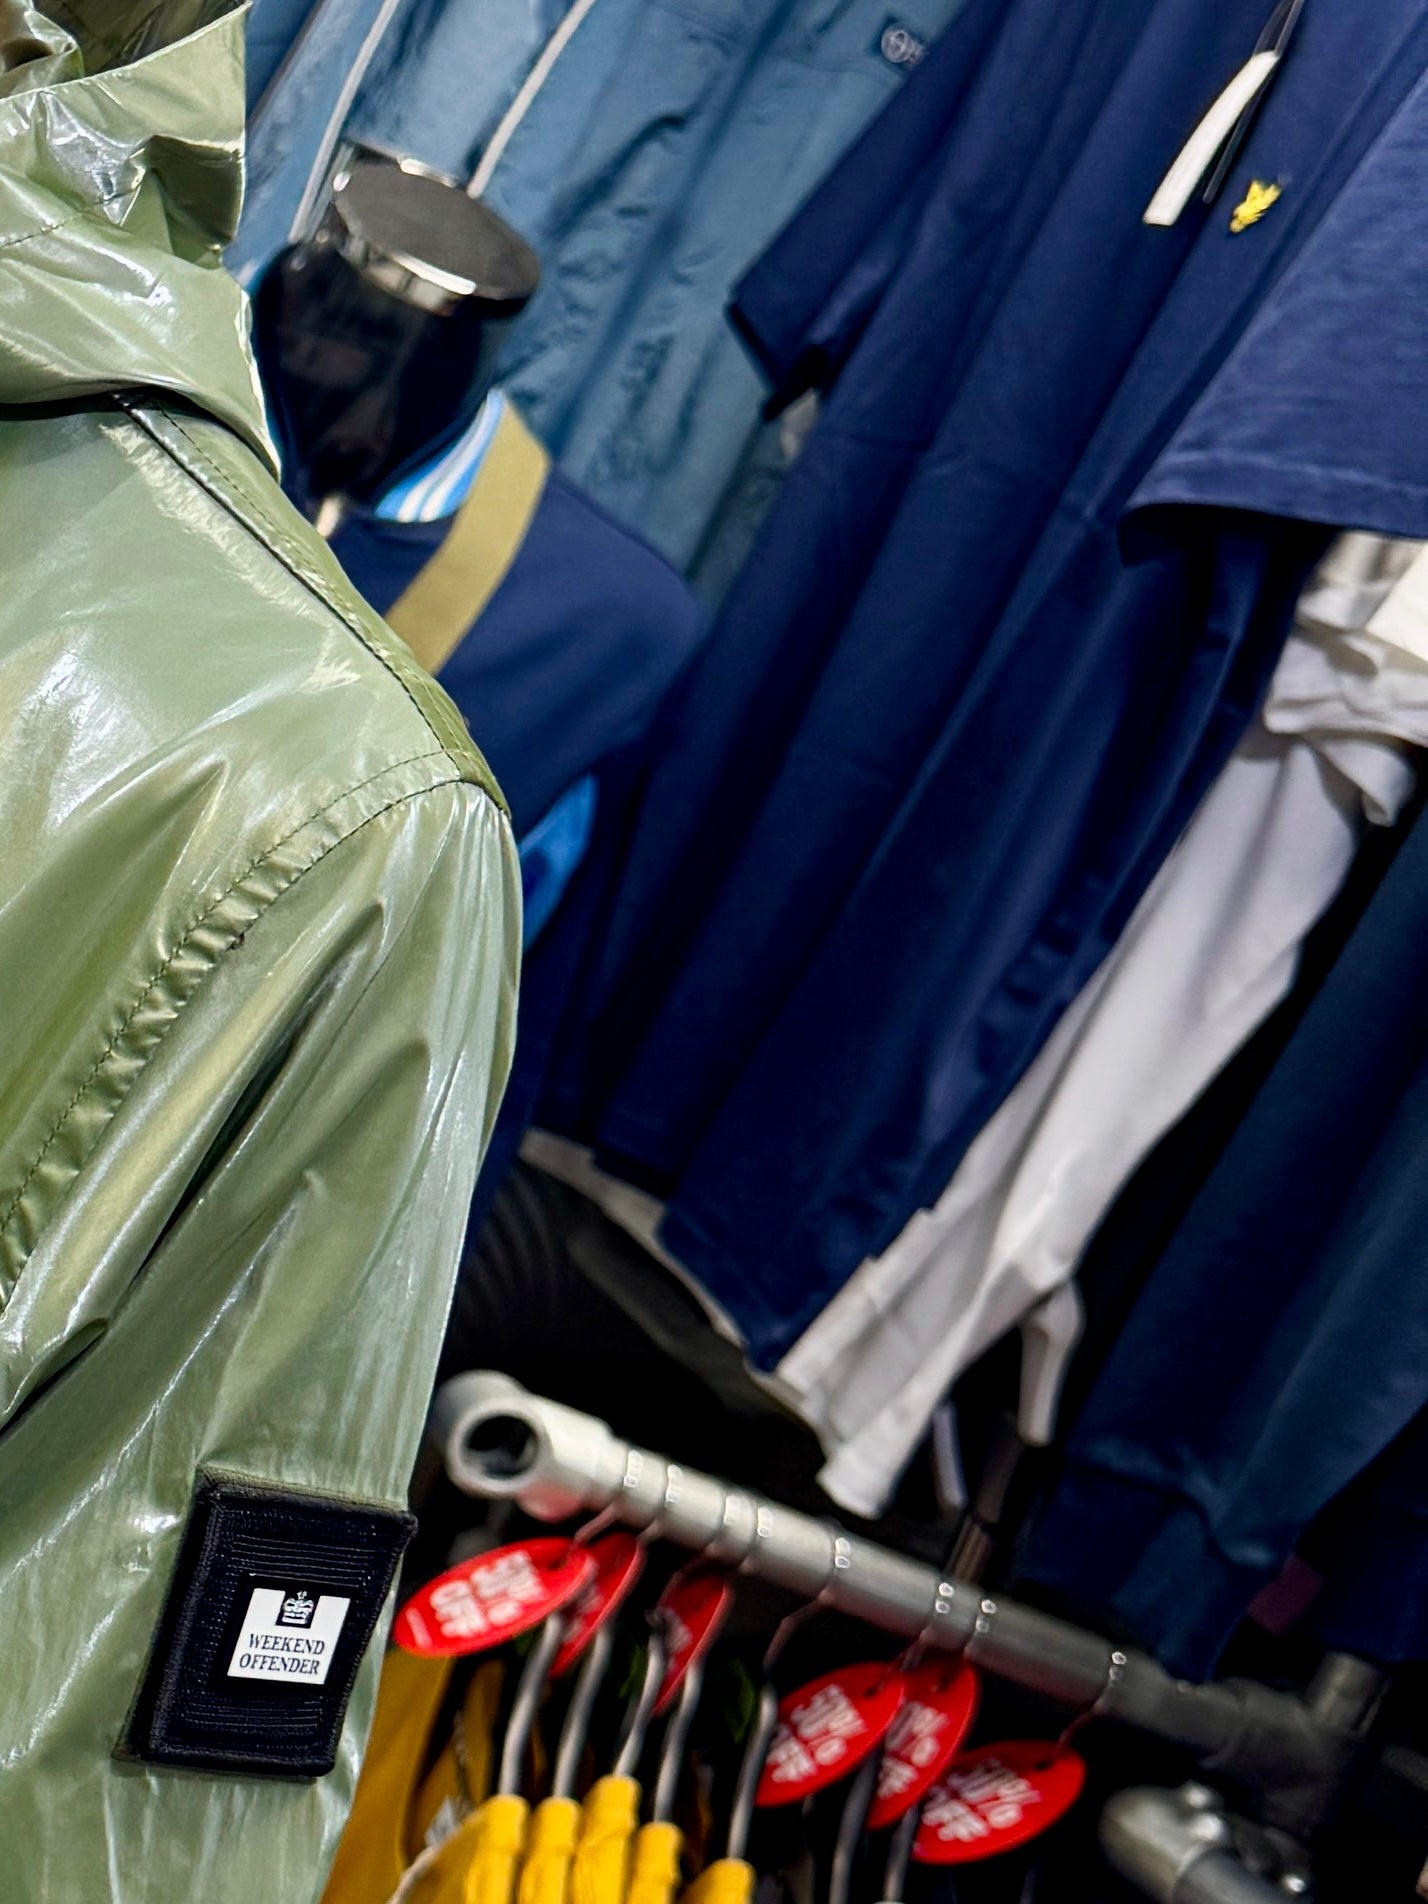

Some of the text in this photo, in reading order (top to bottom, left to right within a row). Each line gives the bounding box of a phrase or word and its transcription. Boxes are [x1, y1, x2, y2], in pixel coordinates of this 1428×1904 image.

[249, 1633, 325, 1655] WEEKEND
[239, 1653, 320, 1675] OFFENDER
[790, 1684, 868, 1767] 50%
